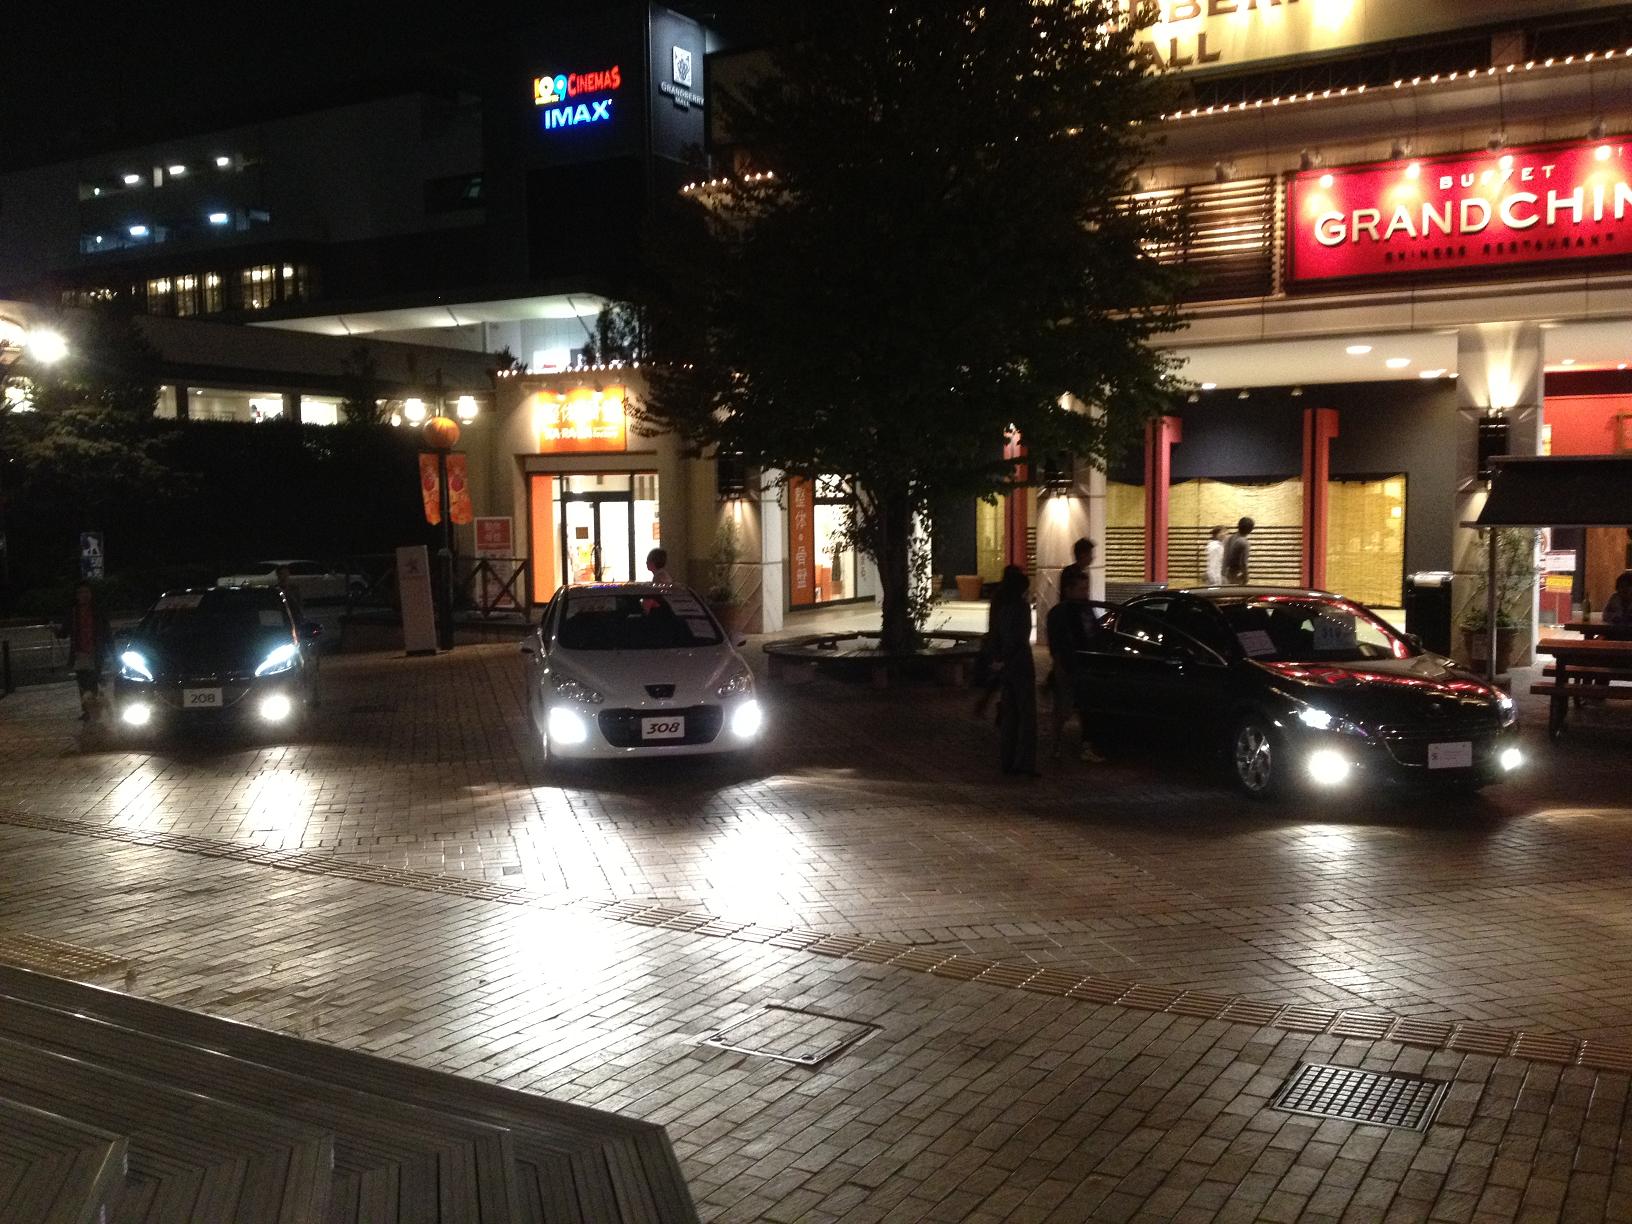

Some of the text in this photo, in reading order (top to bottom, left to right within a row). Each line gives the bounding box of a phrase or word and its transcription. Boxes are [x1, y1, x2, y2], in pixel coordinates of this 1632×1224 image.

[1136, 32, 1221, 69] ALL
[534, 65, 621, 102] 109 CINEMAS
[545, 100, 609, 129] IMAX
[190, 693, 216, 704] 208
[645, 722, 681, 735] 308
